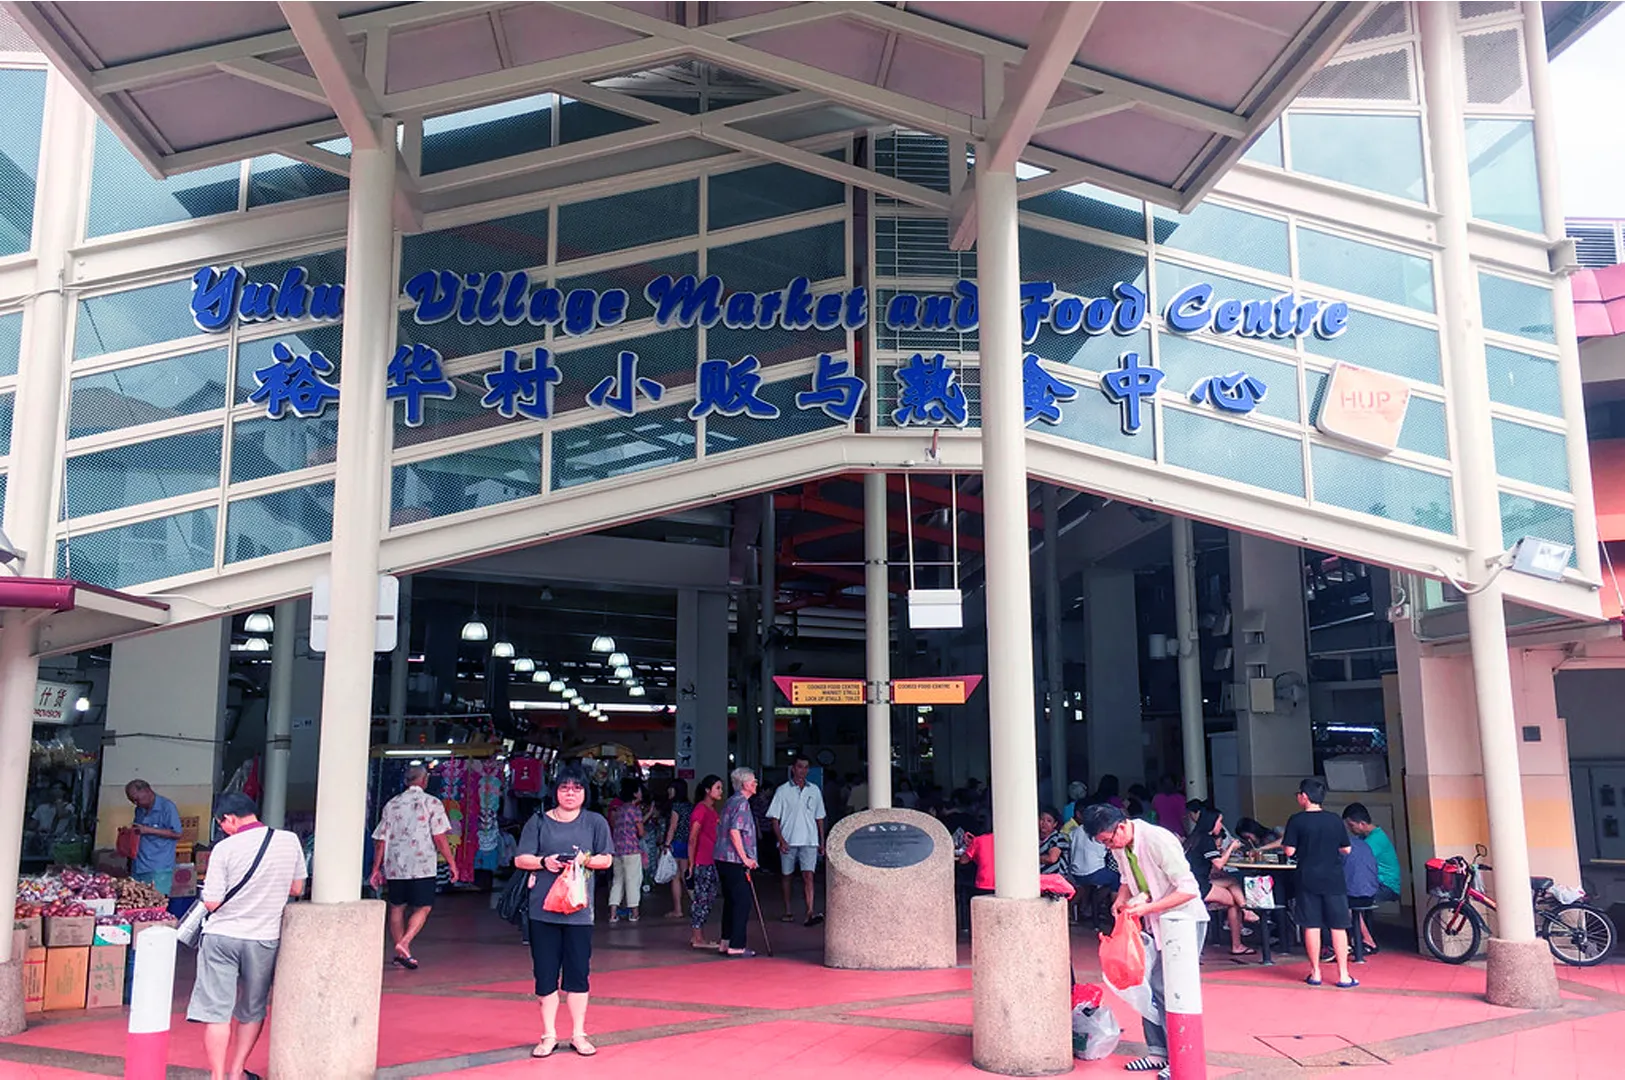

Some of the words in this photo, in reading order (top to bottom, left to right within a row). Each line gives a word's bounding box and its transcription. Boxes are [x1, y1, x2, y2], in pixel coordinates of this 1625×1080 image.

[190, 265, 345, 332] Yuhu
[403, 269, 629, 337] Village
[644, 274, 868, 331] Market
[883, 279, 980, 332] and
[1020, 281, 1147, 344] Food
[1163, 283, 1349, 339] Centre
[1340, 390, 1391, 409] HUP
